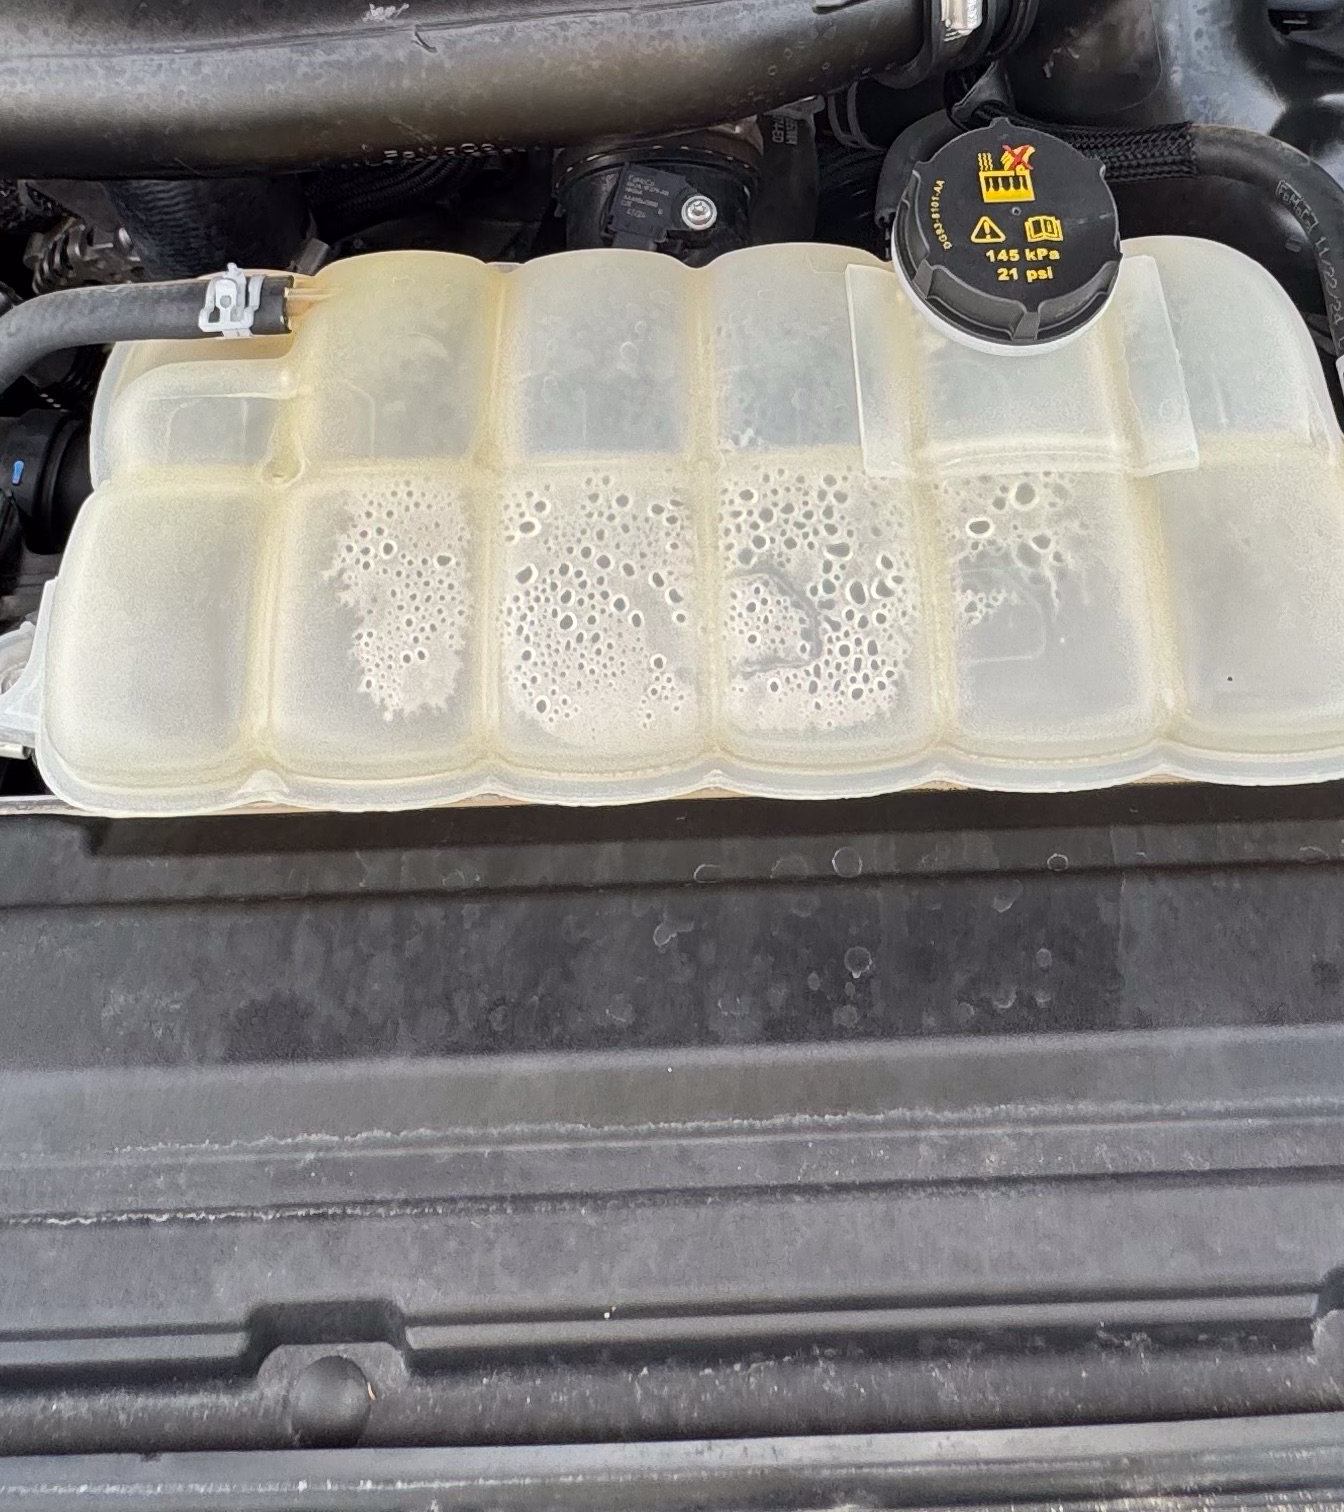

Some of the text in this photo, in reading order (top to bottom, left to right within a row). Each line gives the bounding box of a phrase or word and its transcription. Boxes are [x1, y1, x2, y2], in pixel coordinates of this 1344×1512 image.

[985, 248, 1061, 262] 145 kPa
[997, 266, 1053, 282] 21 psi
